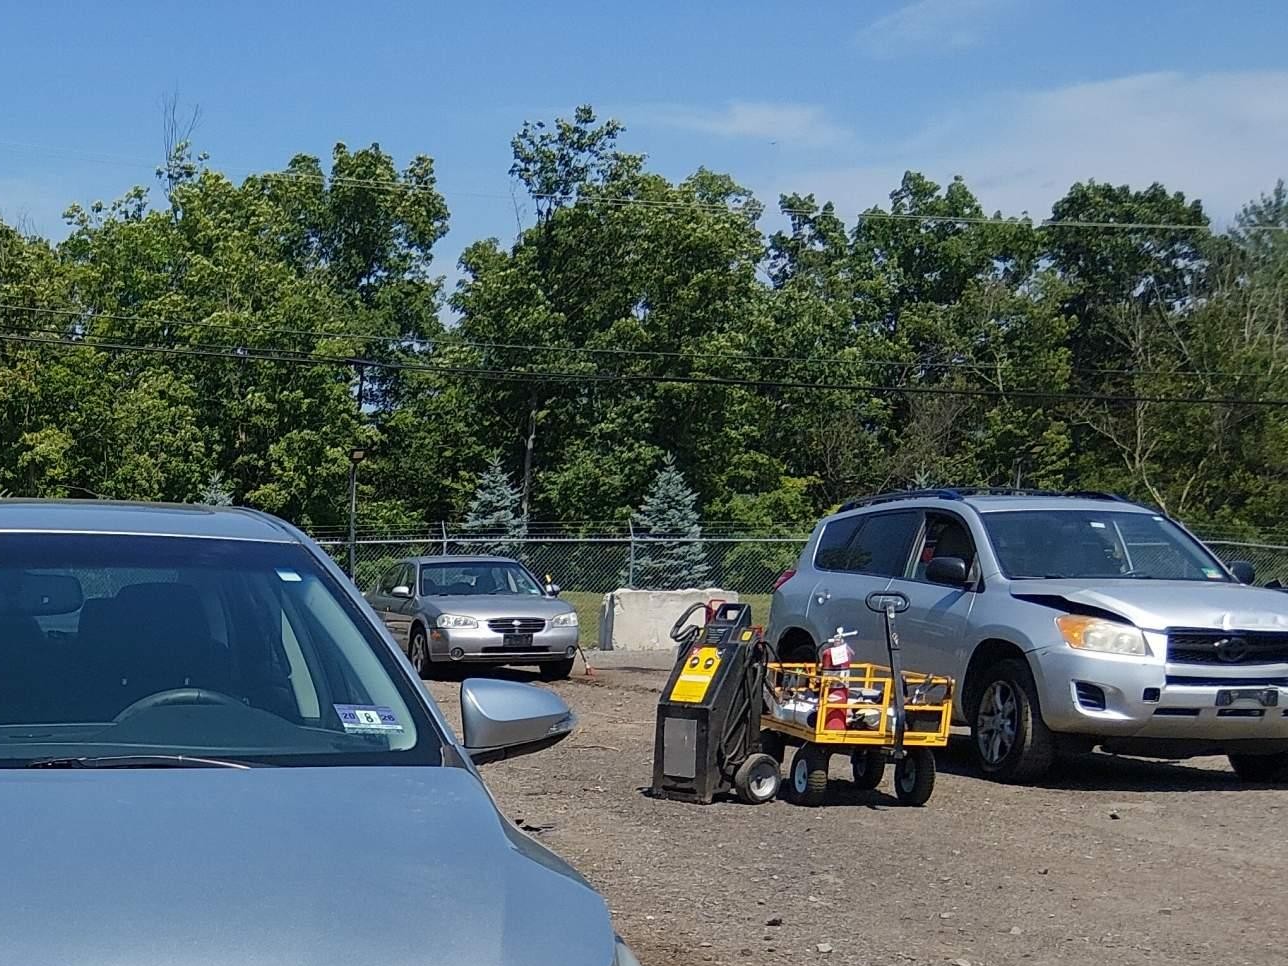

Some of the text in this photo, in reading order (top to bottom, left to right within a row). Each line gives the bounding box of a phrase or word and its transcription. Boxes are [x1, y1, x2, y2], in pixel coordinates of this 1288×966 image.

[342, 712, 395, 723] 20 8 26
